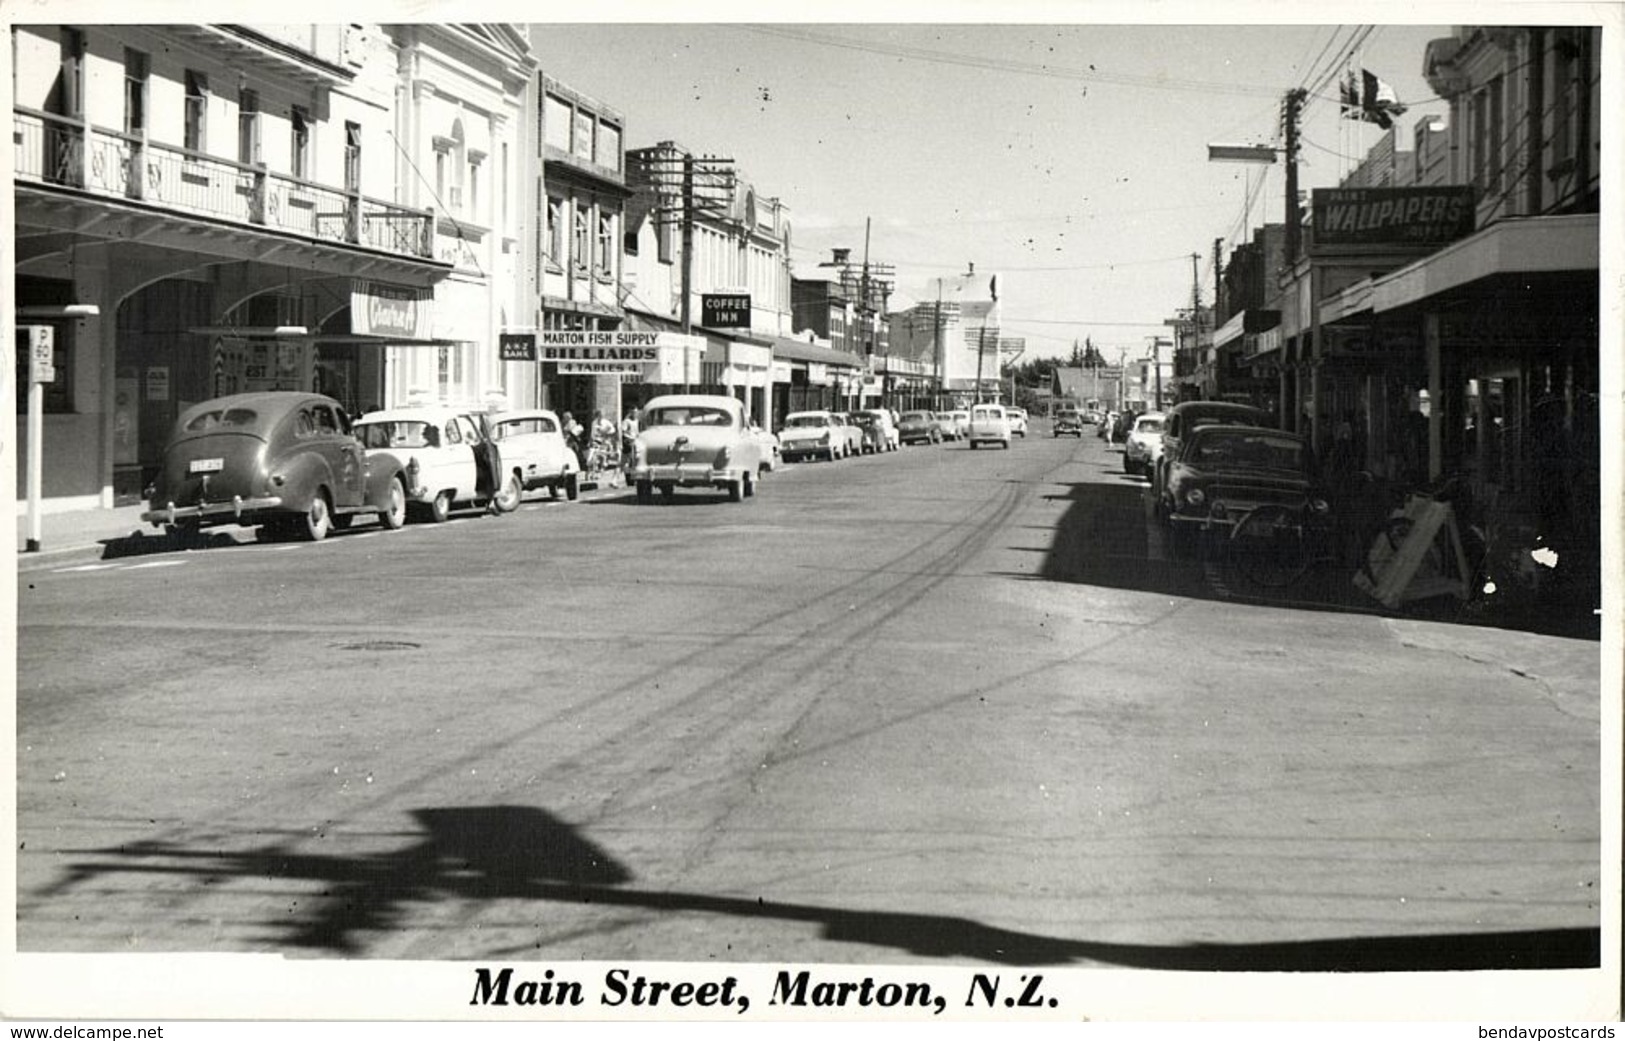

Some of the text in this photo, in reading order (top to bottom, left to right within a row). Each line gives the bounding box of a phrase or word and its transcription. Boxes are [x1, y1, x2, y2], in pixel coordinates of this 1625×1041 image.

[1324, 195, 1462, 234] WALLPAPERS
[706, 298, 749, 310] COFFEE
[715, 311, 738, 323] INN
[543, 332, 658, 345] MARTON FISH SUPPLY
[503, 350, 530, 359] BANK
[545, 347, 657, 360] BILLIARDS
[564, 363, 637, 372] 4 TABLES 4
